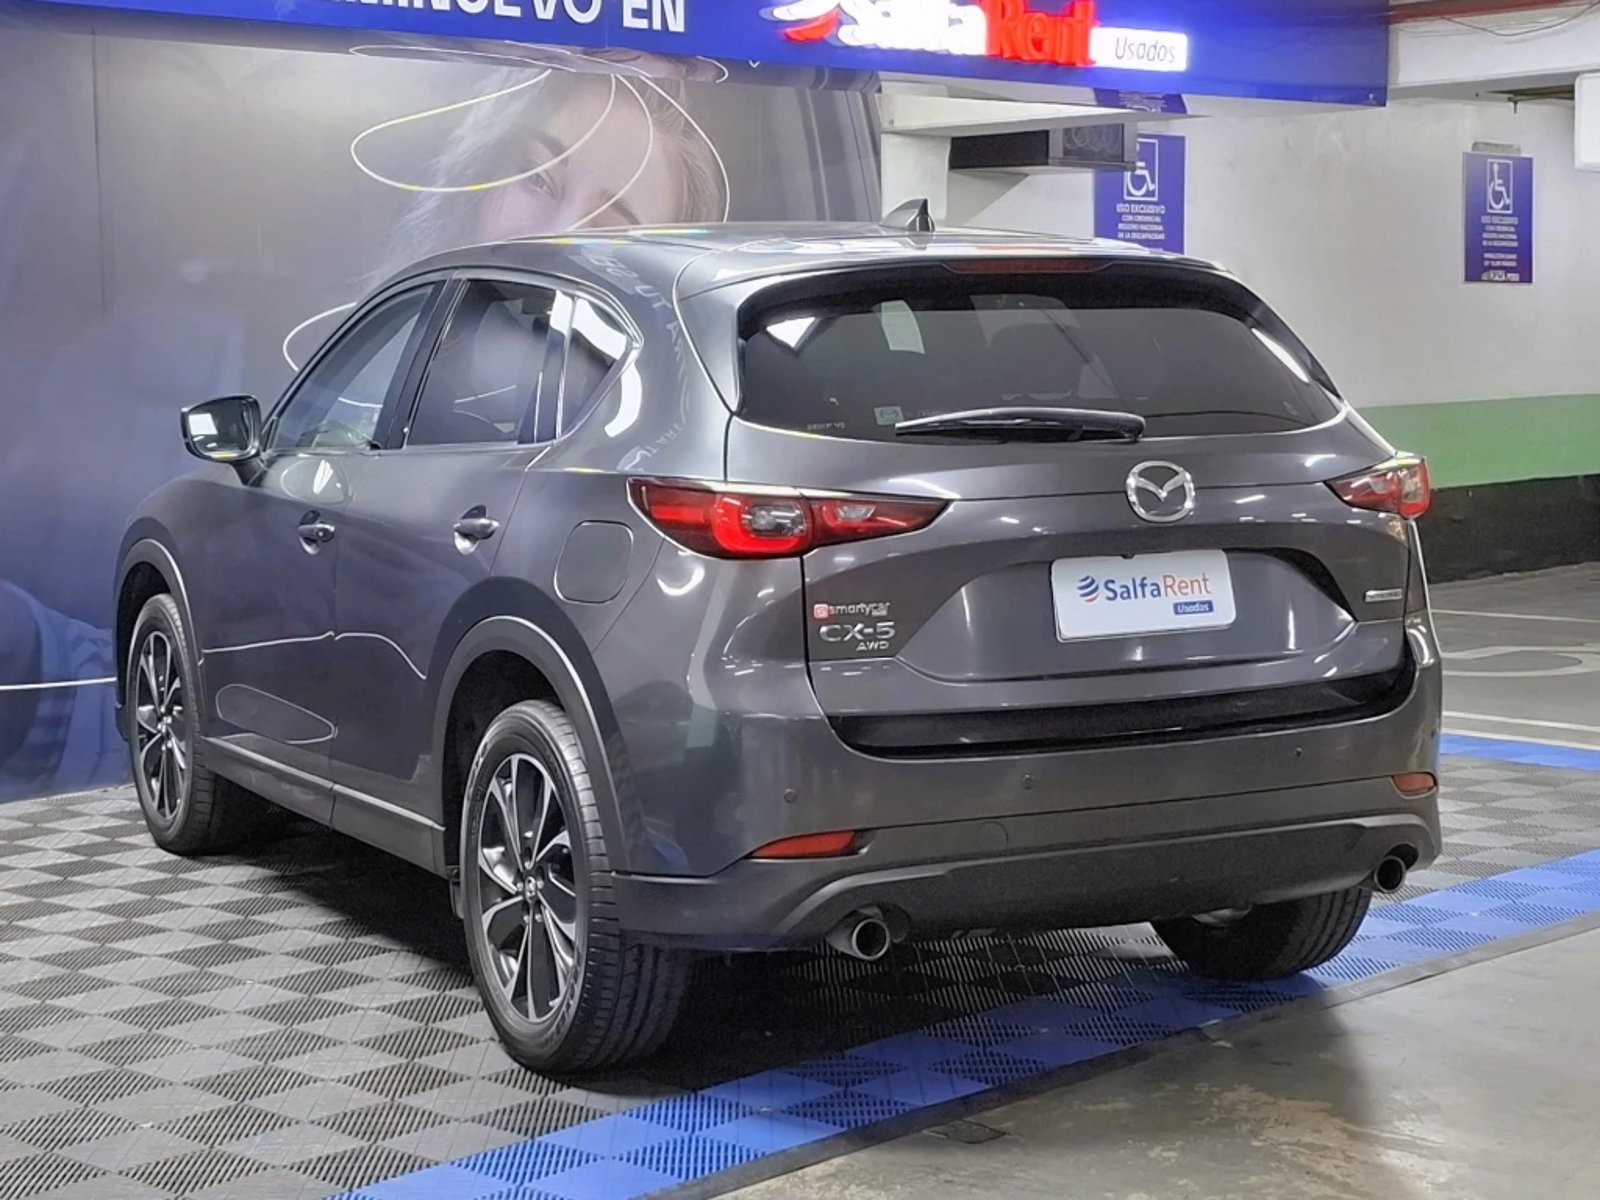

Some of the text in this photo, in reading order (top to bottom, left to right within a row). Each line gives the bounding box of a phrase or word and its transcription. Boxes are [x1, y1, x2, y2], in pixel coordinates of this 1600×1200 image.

[623, 0, 685, 32] EN
[1115, 37, 1175, 63] Usados
[1103, 573, 1211, 601] SalfaRent
[1177, 602, 1209, 613] Usados
[819, 621, 896, 642] CX-5
[856, 640, 890, 651] AWD
